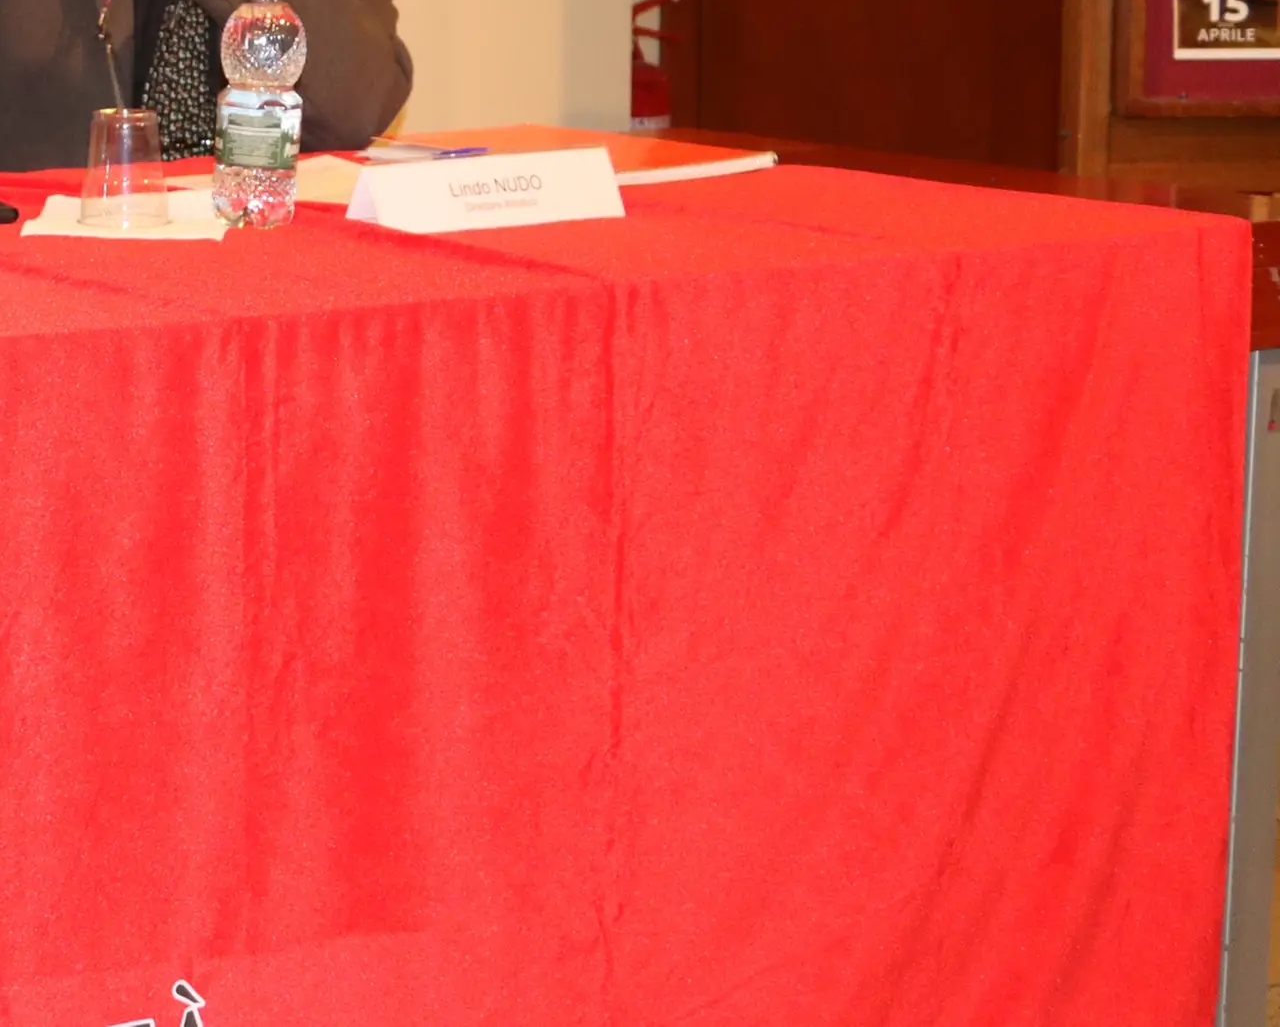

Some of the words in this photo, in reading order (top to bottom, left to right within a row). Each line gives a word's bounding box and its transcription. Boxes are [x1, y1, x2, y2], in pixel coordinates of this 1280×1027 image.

[1197, 28, 1256, 43] APRILE
[448, 180, 492, 198] Lindo
[493, 174, 543, 194] NUDO
